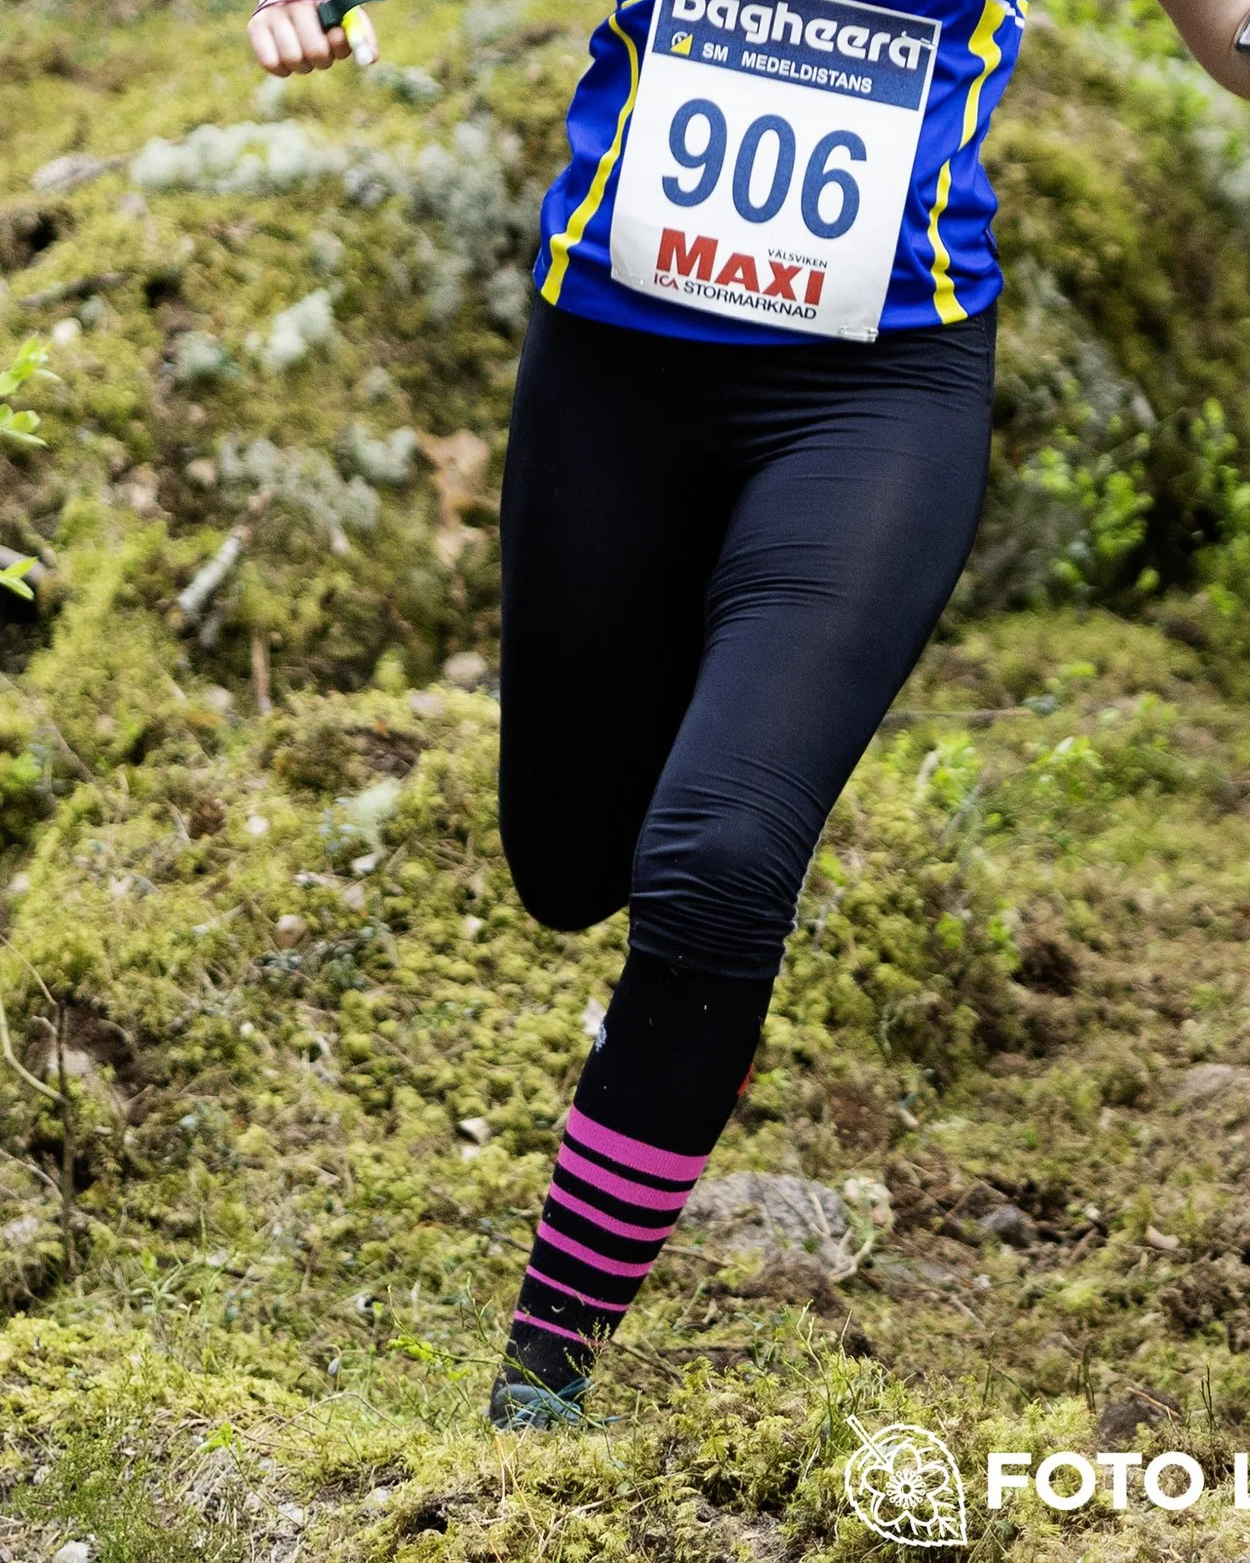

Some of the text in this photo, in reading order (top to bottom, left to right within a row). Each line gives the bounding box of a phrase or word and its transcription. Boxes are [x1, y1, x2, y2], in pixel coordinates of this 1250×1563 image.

[702, 42, 873, 94] SM MEDELDISTANS
[662, 98, 867, 239] 906
[656, 227, 826, 306] MAXI
[768, 248, 828, 268] VÄLSVIKEN
[653, 272, 817, 319] ICA STORMARKNAD
